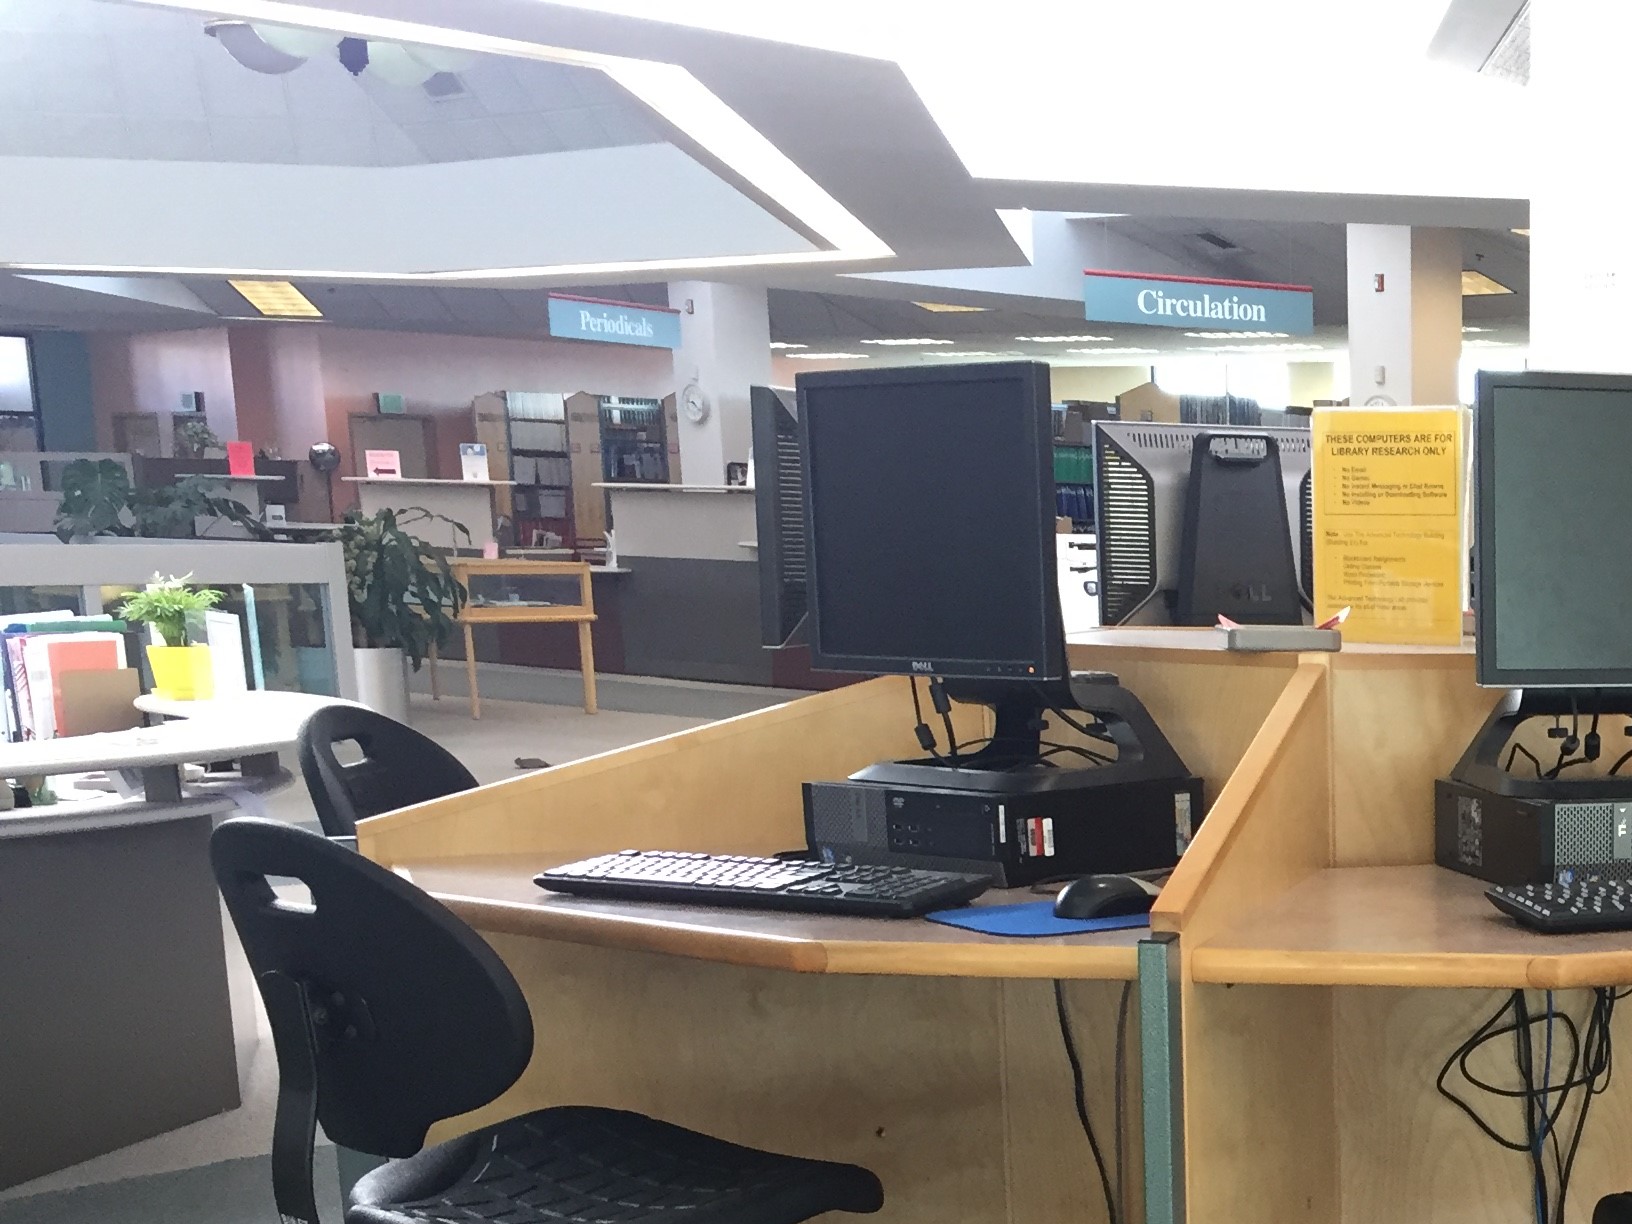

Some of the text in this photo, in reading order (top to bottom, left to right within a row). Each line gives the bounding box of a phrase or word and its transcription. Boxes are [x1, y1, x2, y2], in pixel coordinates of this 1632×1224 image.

[1137, 289, 1266, 322] Circulation
[580, 310, 653, 337] Periodicals
[1326, 433, 1453, 444] THESE COMPUTERS ARE FOR
[1331, 446, 1447, 456] LIBRARY RESEARCH ONLY
[912, 661, 934, 671] DELL
